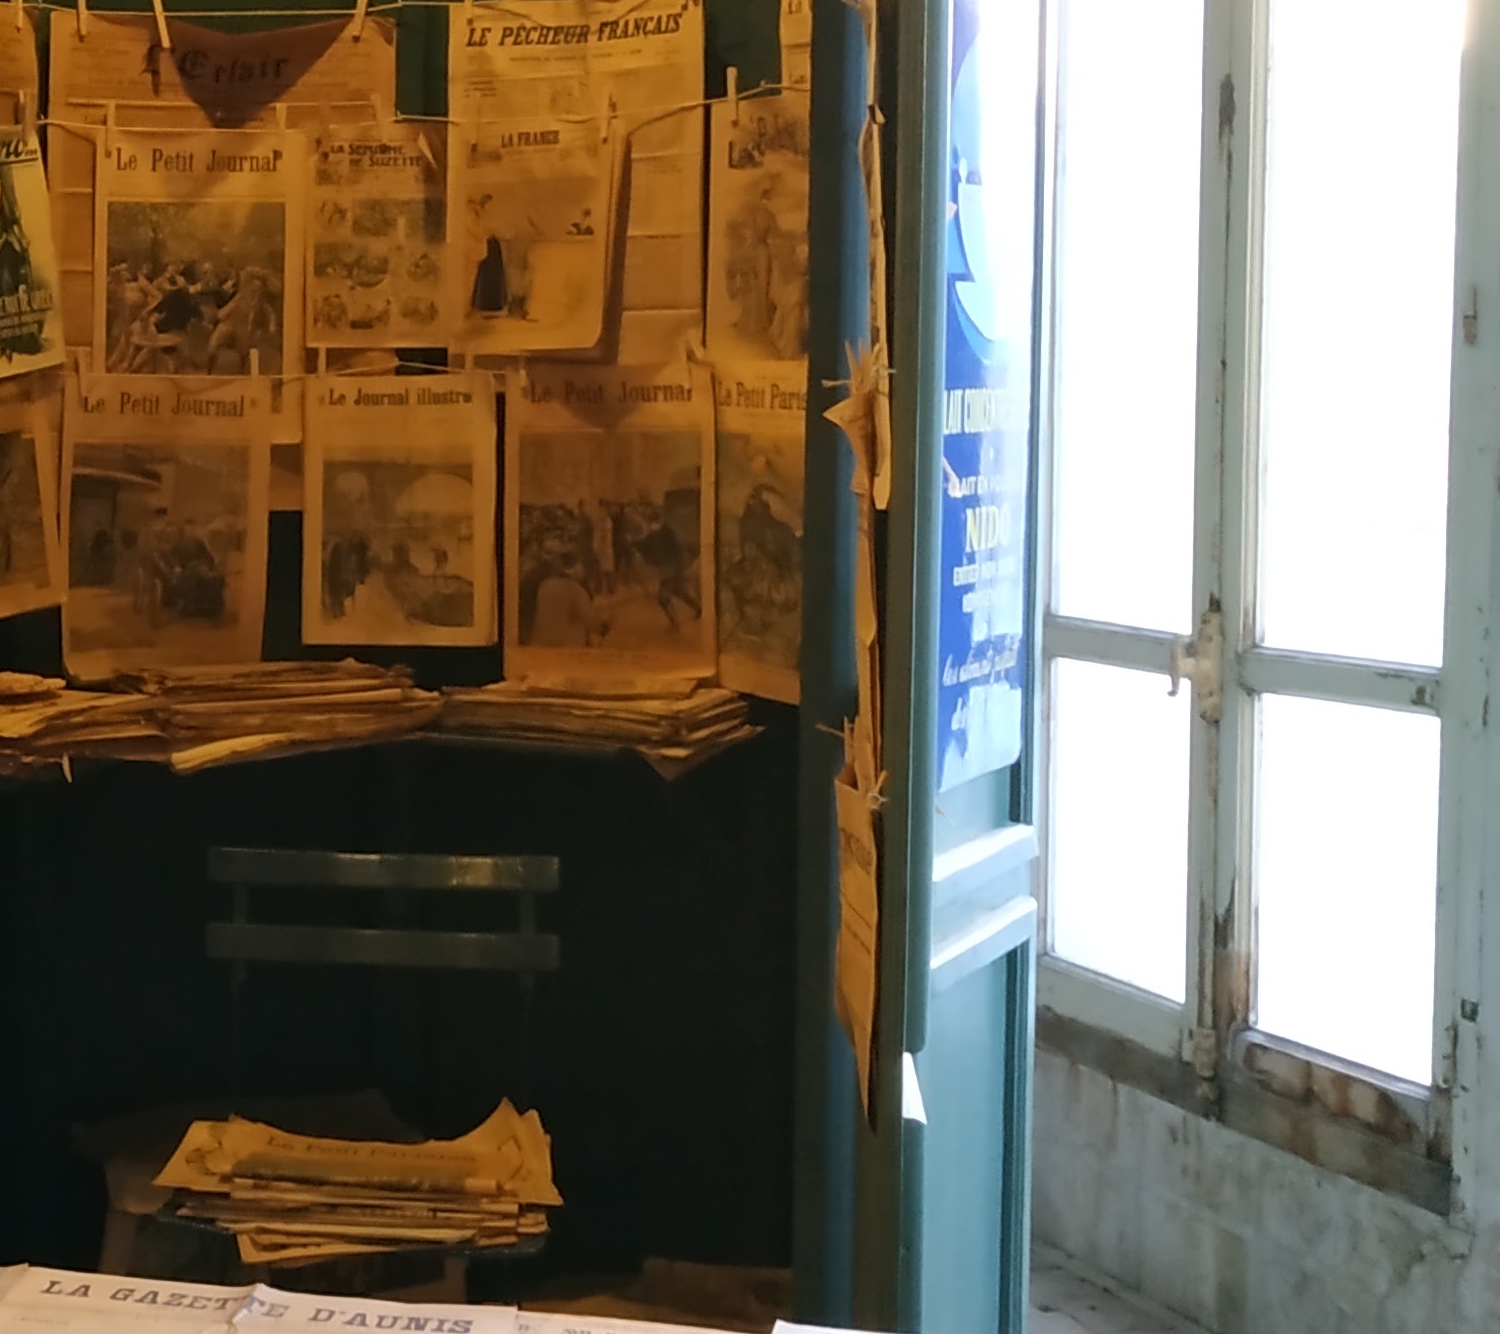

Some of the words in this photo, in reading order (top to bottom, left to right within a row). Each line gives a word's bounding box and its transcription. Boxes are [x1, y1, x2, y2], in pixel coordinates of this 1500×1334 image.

[466, 27, 492, 48] LE
[499, 23, 592, 47] PÊCHEUR
[501, 133, 514, 148] LA
[518, 130, 560, 147] FRANCE
[115, 147, 138, 171] Le
[152, 148, 195, 173] Petit
[206, 149, 279, 173] Journal
[83, 395, 106, 414] Le
[119, 391, 160, 416] Petit
[171, 392, 245, 418] Journal
[328, 388, 347, 406] Le
[353, 387, 410, 406] Journal
[529, 380, 551, 404] Le
[965, 503, 1012, 553] NIDO
[39, 1279, 92, 1300] LA
[109, 1286, 291, 1320] GAZETTE
